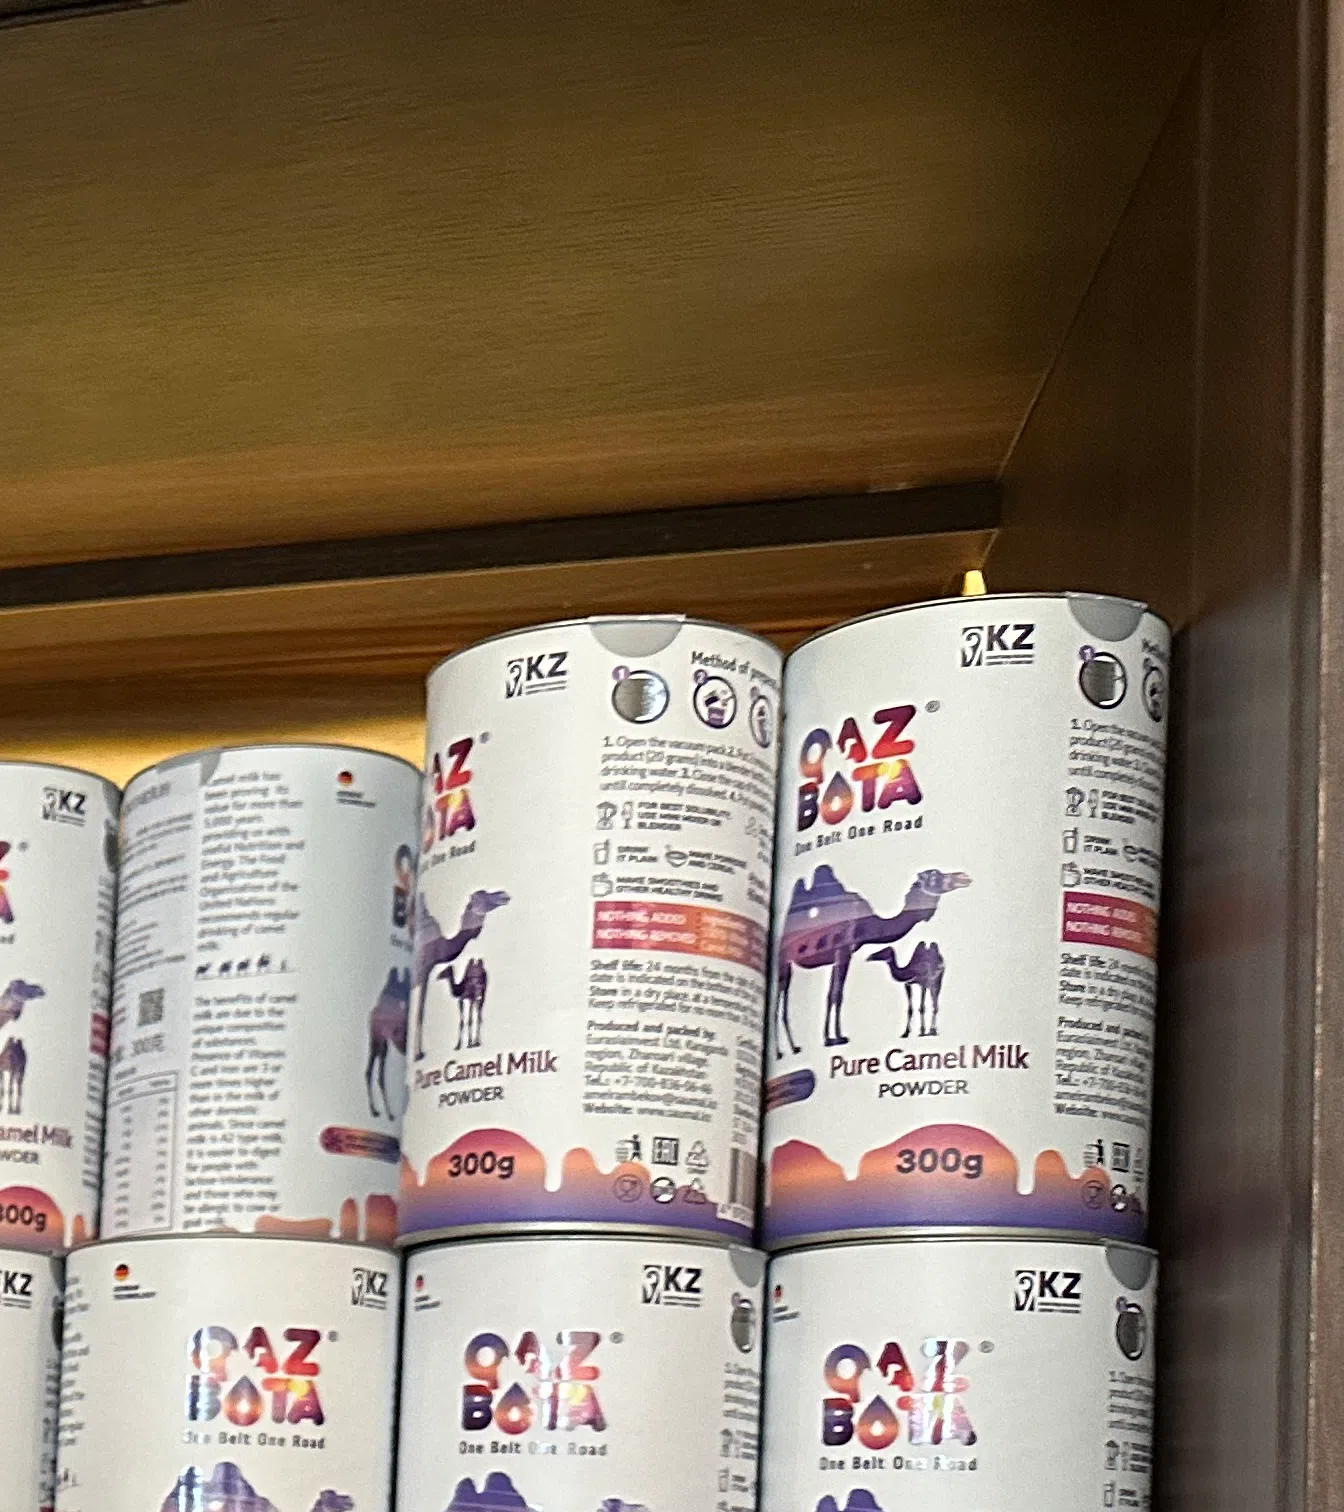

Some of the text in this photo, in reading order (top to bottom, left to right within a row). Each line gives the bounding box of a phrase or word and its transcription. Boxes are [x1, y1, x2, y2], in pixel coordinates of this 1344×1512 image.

[986, 624, 1035, 651] KZ
[526, 651, 568, 678] KZ
[883, 816, 923, 834] Road
[445, 1055, 503, 1082] Camel
[506, 1050, 558, 1076] Milk
[830, 1044, 1030, 1078] Pure Camel Milk
[438, 1087, 503, 1108] POWDER
[878, 1080, 968, 1098] POWDER
[448, 1151, 514, 1178] 300g
[896, 1147, 983, 1178] 300g
[4, 1272, 32, 1296] KZ
[664, 1267, 703, 1294] KZ
[1039, 1272, 1082, 1300] KZ
[219, 1432, 325, 1449] Belt One Road
[460, 1441, 483, 1454] One
[490, 1441, 520, 1454] Belt
[820, 1457, 844, 1470] One
[852, 1456, 884, 1470] Belt
